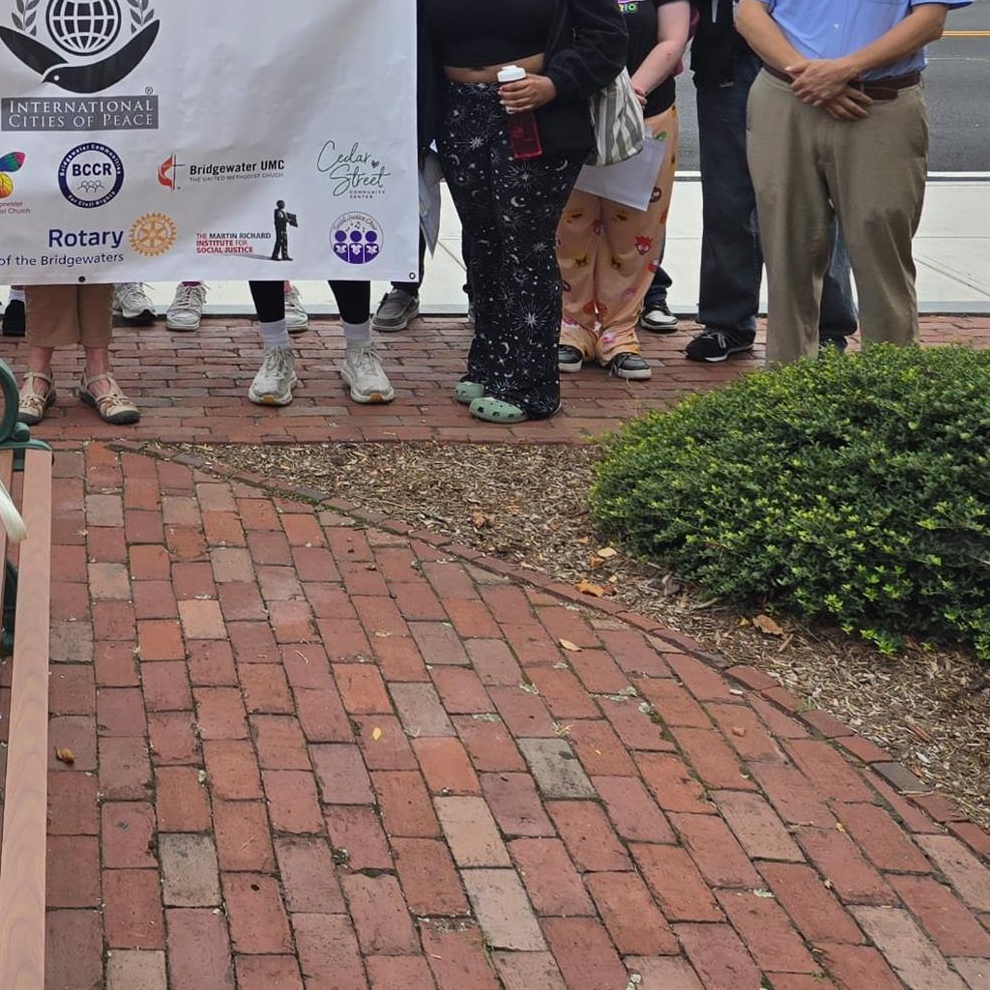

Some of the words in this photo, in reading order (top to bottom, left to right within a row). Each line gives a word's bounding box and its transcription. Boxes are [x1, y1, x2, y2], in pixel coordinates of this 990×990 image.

[10, 100, 154, 113] INTERNATIONAL
[9, 114, 65, 128] CITIES
[73, 115, 95, 128] OF
[103, 113, 154, 127] PEACE
[317, 140, 371, 172] Cedar
[72, 163, 112, 177] BCCR
[190, 162, 258, 176] Bridgewater
[260, 159, 285, 171] UMC
[227, 173, 260, 181] METHODIST
[330, 163, 391, 196] Street
[48, 229, 124, 249] Rotary
[15, 255, 37, 266] the
[40, 252, 125, 268] Bridgewaters
